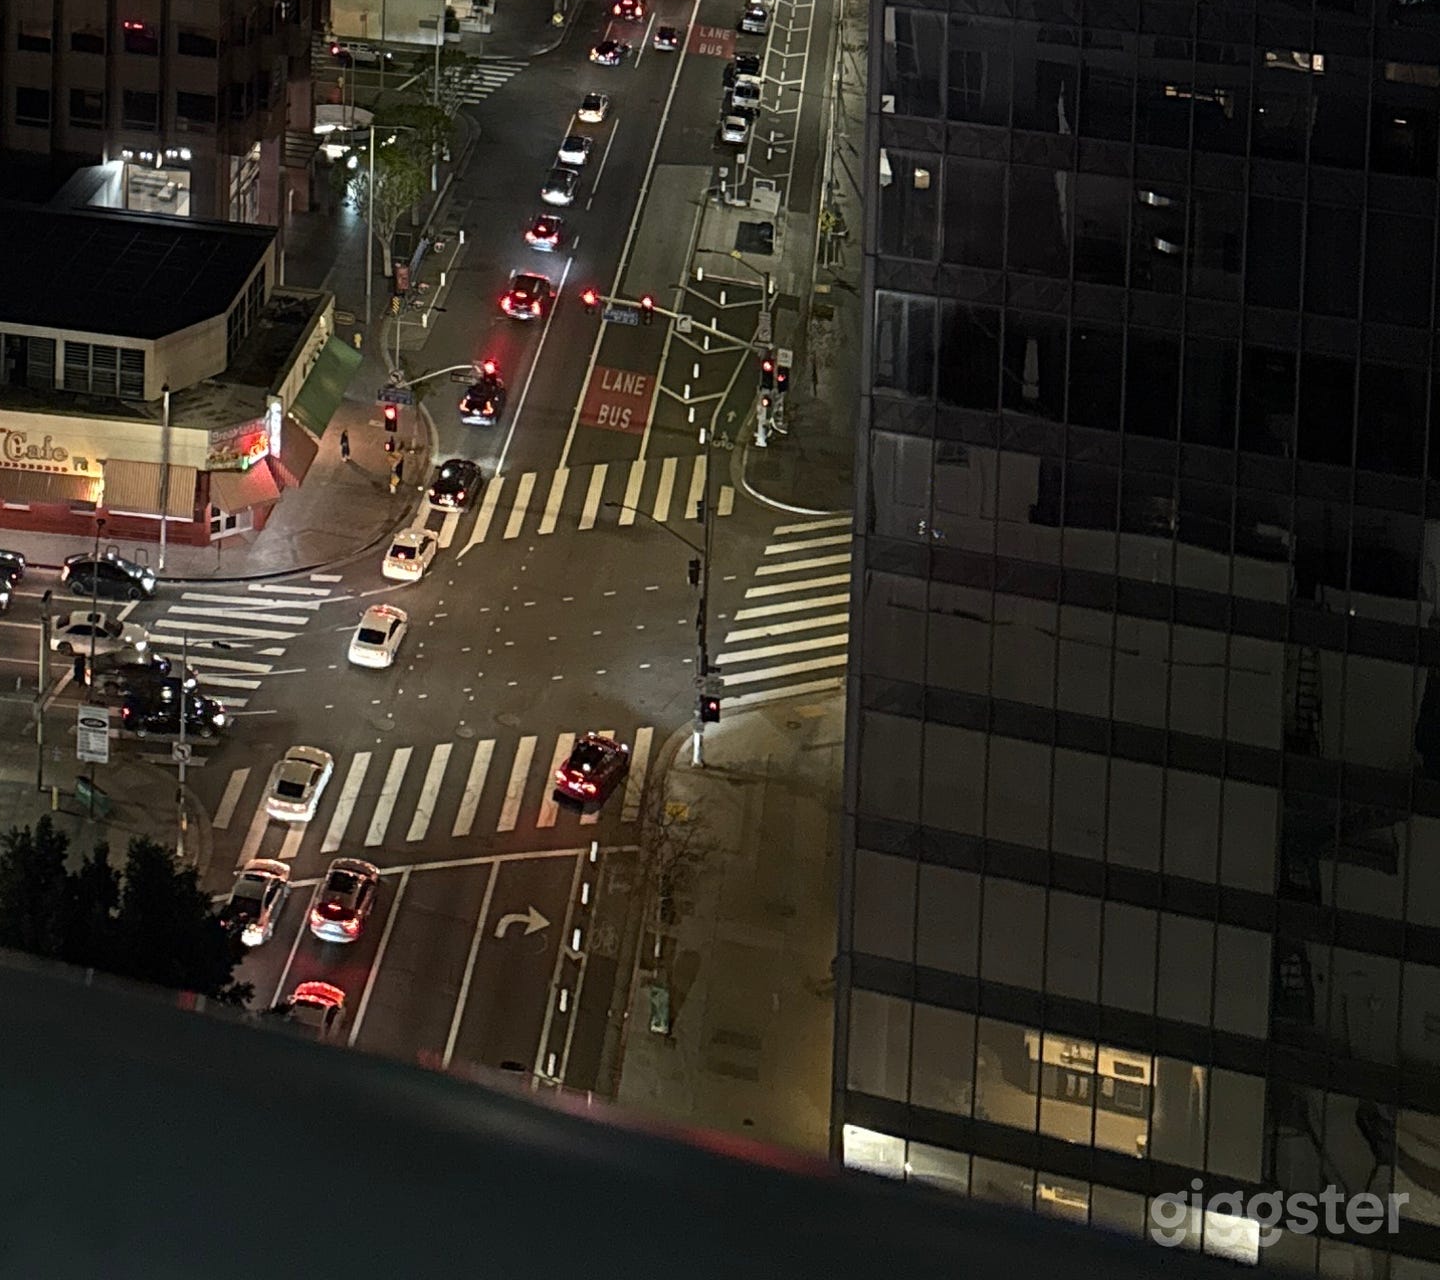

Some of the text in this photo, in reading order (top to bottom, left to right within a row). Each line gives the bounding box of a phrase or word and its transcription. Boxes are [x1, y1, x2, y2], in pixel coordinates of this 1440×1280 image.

[699, 26, 731, 40] LANE
[699, 43, 723, 56] BUS
[601, 370, 646, 396] LANE
[597, 404, 633, 429] BUS
[2, 430, 69, 462] Cafe
